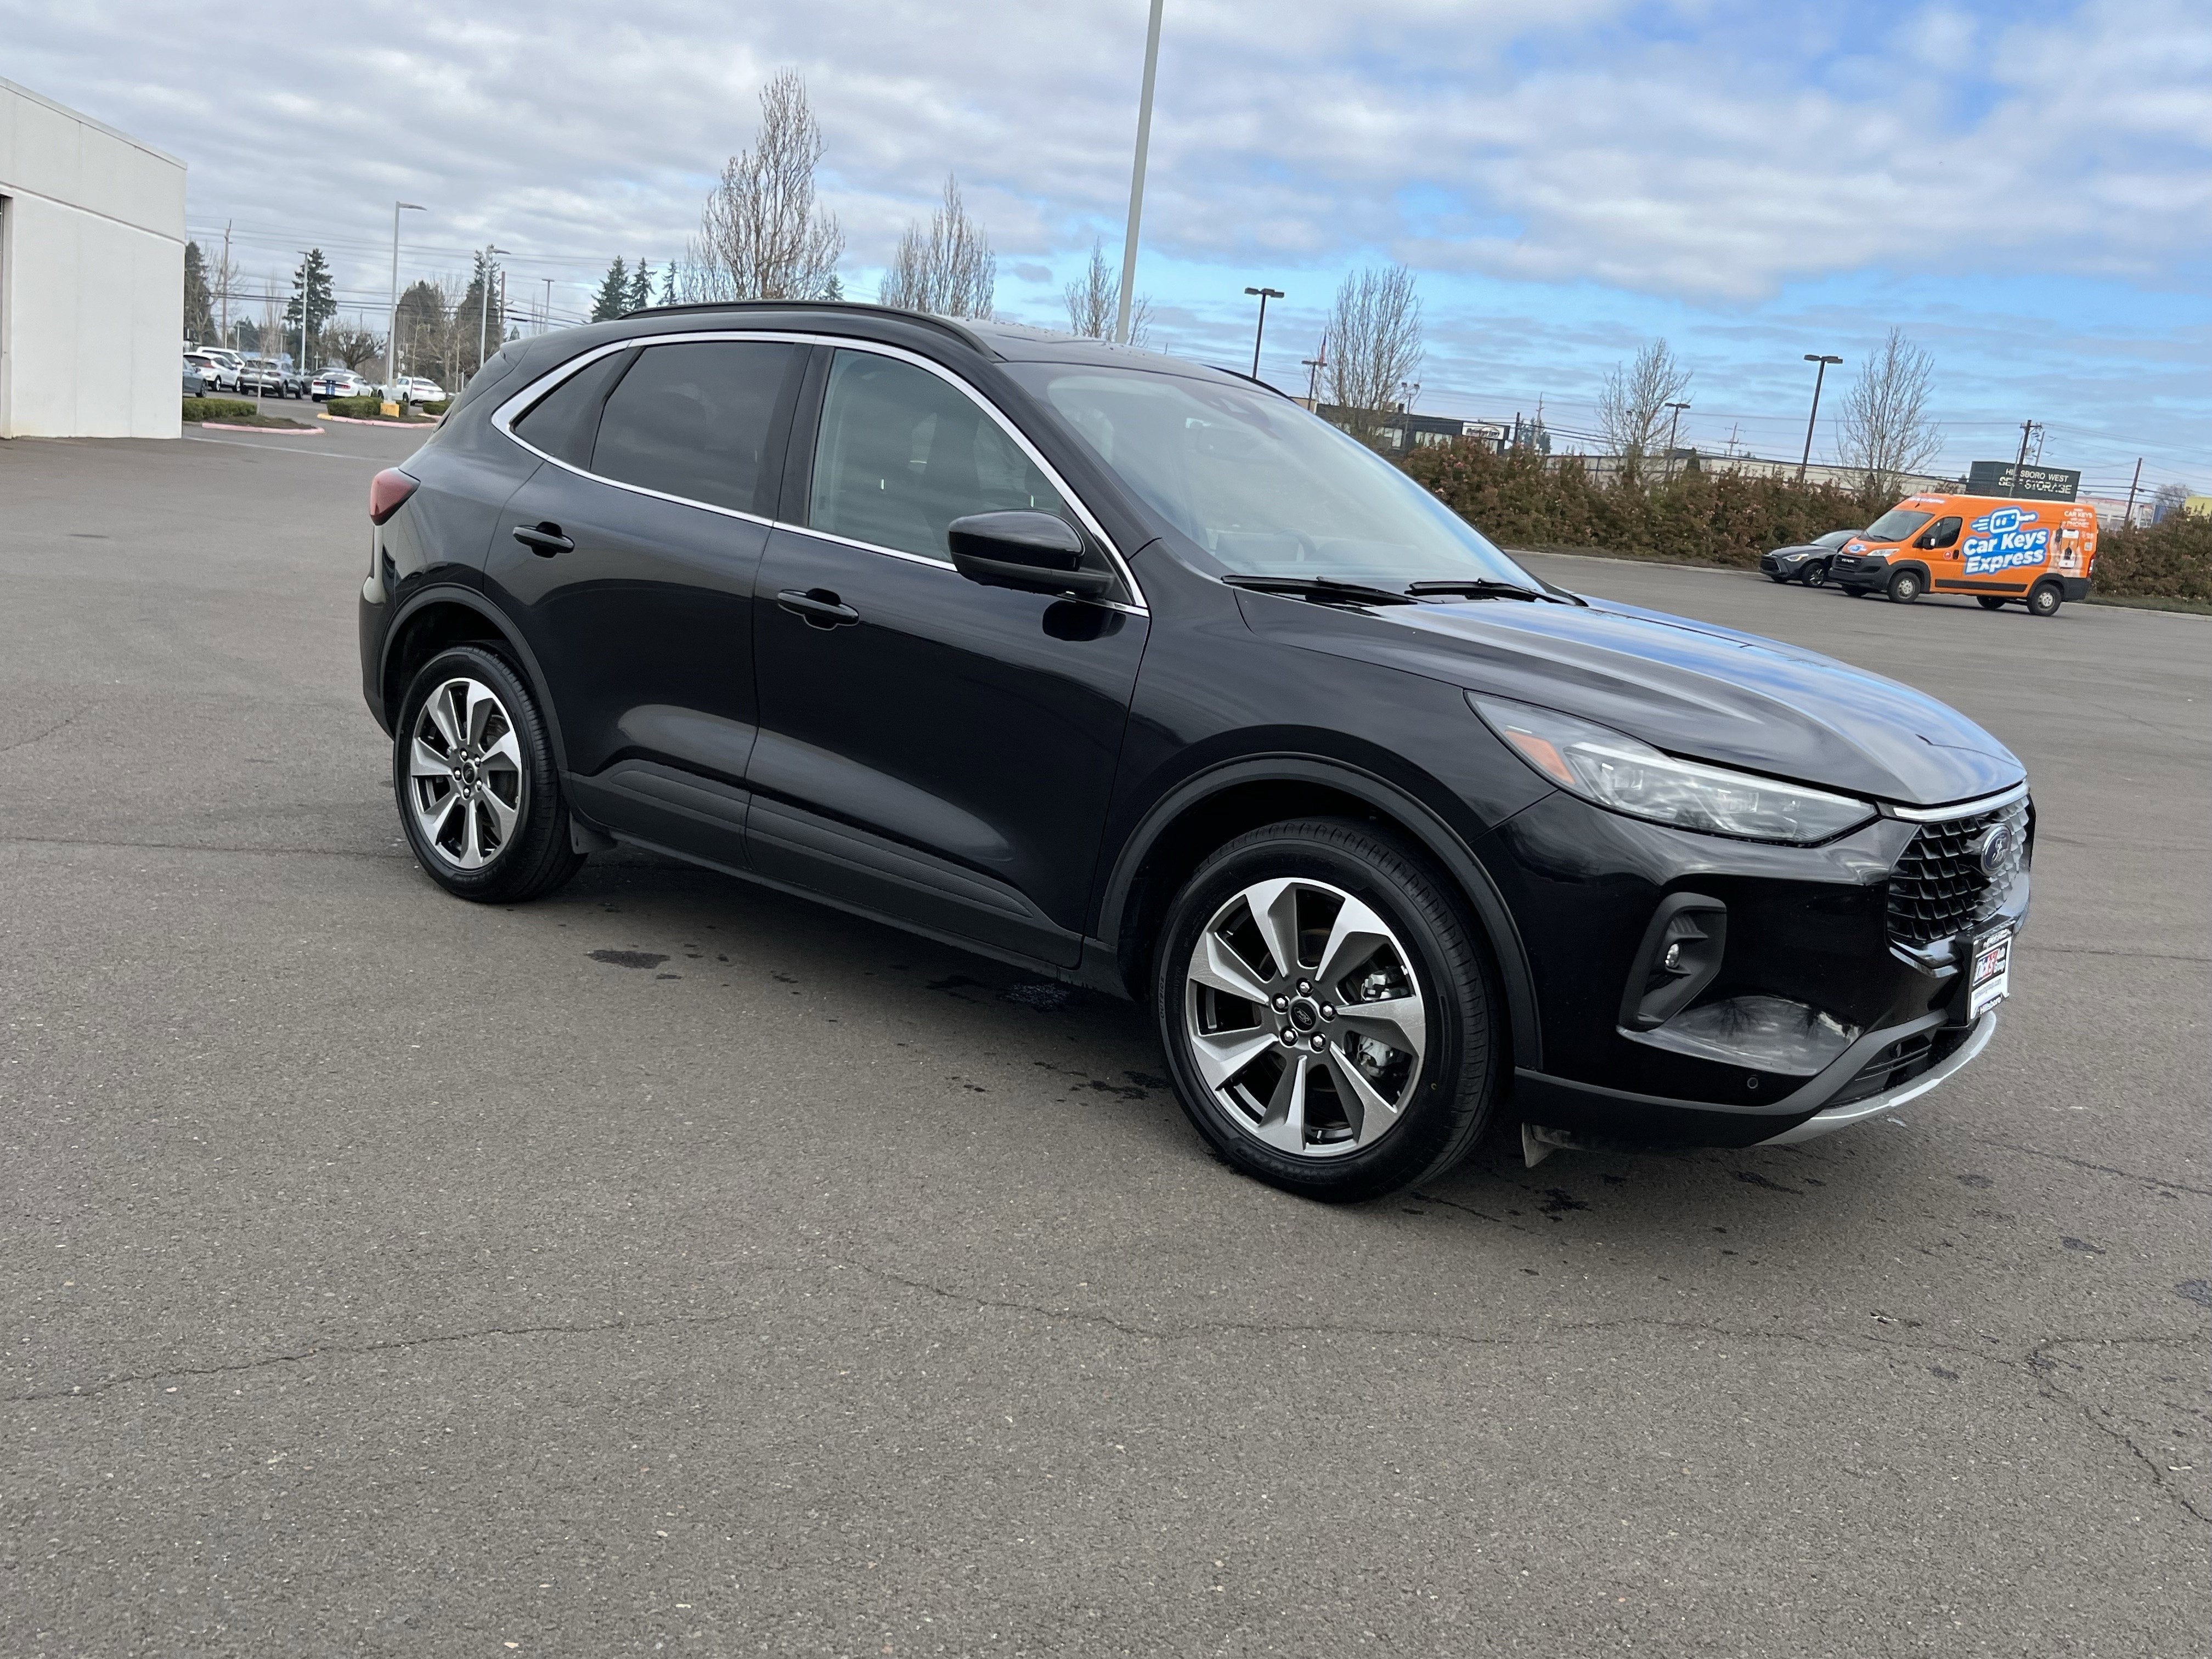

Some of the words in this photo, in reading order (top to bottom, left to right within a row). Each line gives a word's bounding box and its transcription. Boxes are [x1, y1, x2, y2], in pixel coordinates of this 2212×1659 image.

[2005, 468, 2046, 480] HISBORO
[2048, 473, 2069, 483] WEST
[1963, 538, 1998, 556] Car
[2000, 531, 2047, 550] Keys
[1966, 549, 2044, 573] Express
